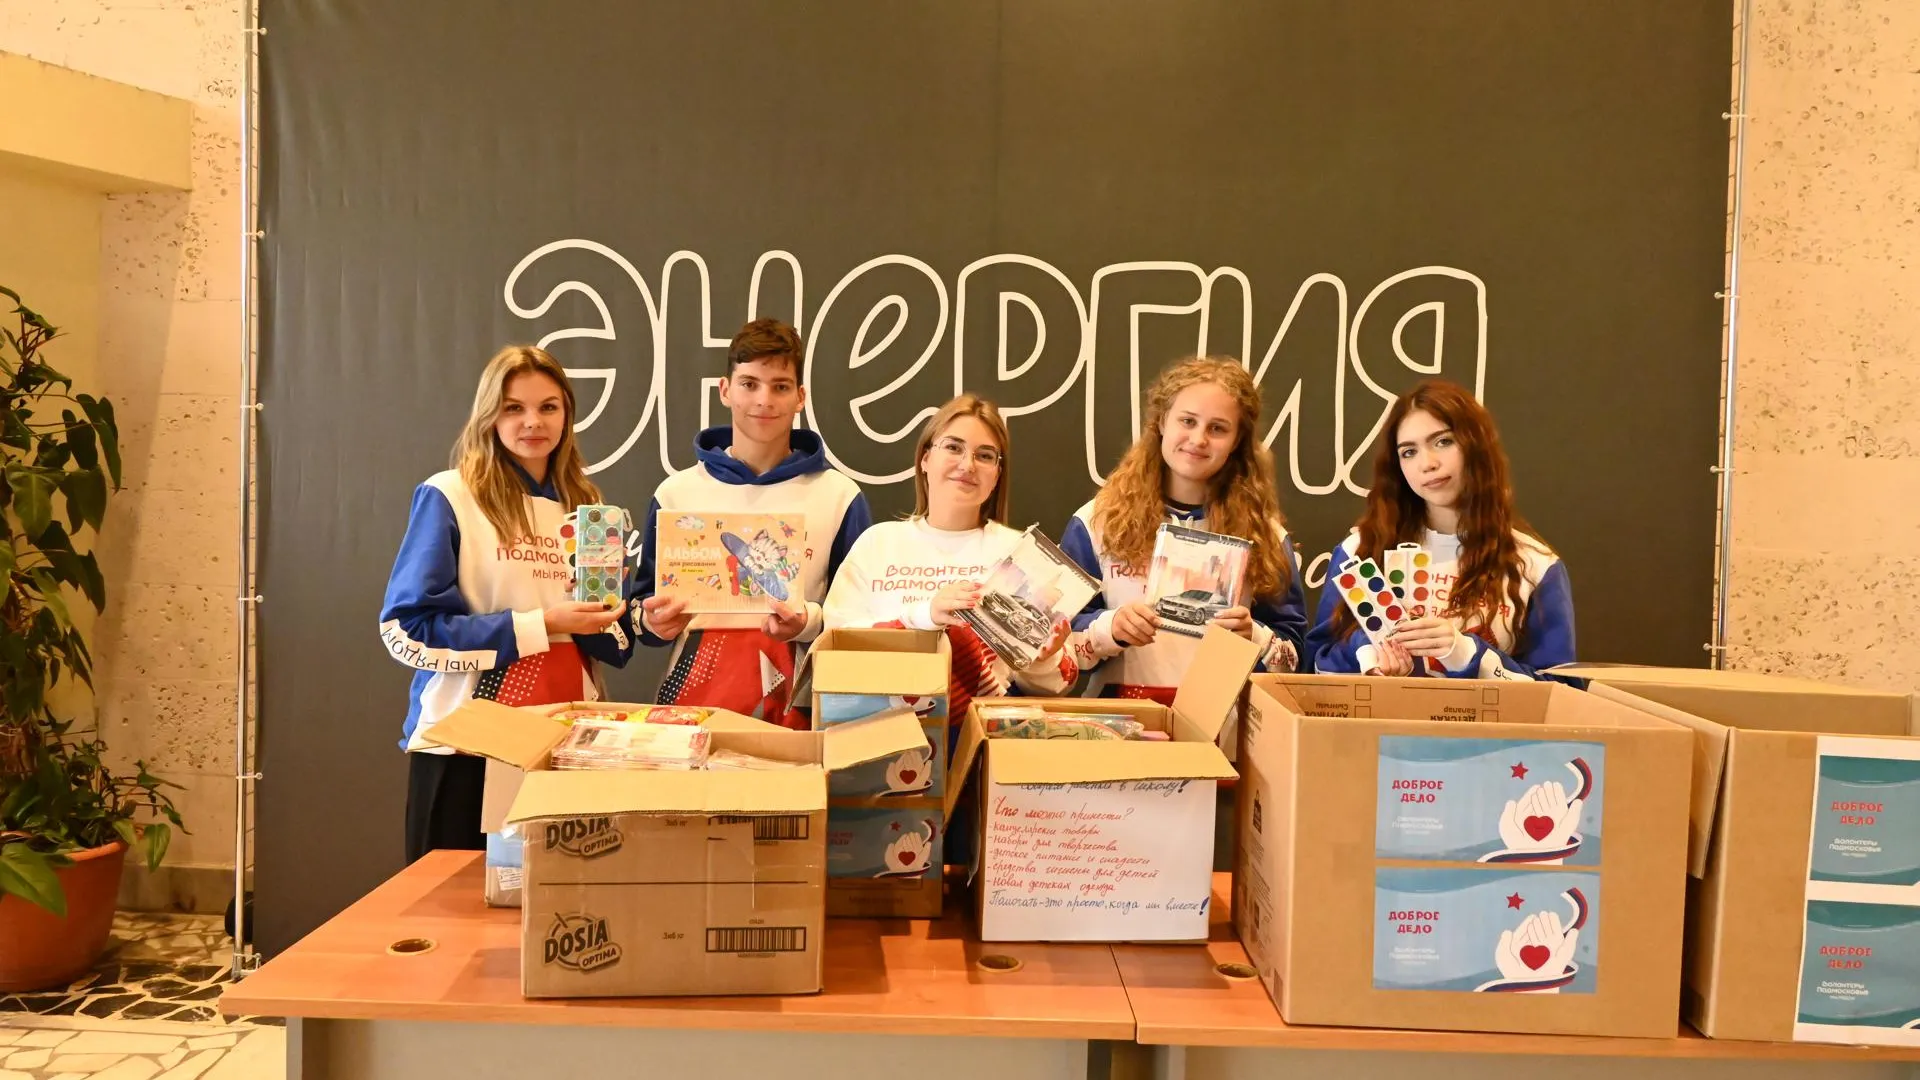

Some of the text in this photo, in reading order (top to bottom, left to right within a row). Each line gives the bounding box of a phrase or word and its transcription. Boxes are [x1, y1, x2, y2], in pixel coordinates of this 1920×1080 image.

[381, 627, 479, 672] МЫ РЯДОМ
[1392, 779, 1444, 790] ДОБРОЕ
[1400, 792, 1436, 804] ДЕЛО
[995, 796, 1019, 817] Что
[1832, 801, 1884, 813] ДОБРОЕ
[1840, 815, 1875, 826] ДЕЛО
[546, 817, 611, 850] DOSIA
[583, 834, 619, 853] OPTIMA
[1388, 910, 1440, 921] ДОБРОЕ
[1397, 923, 1432, 934] ДЕЛО
[544, 919, 609, 965] DOSIA
[582, 947, 617, 967] OPTIMA
[1818, 946, 1872, 957] ДОБРОЕ
[1828, 959, 1864, 969] ДЕЛО
